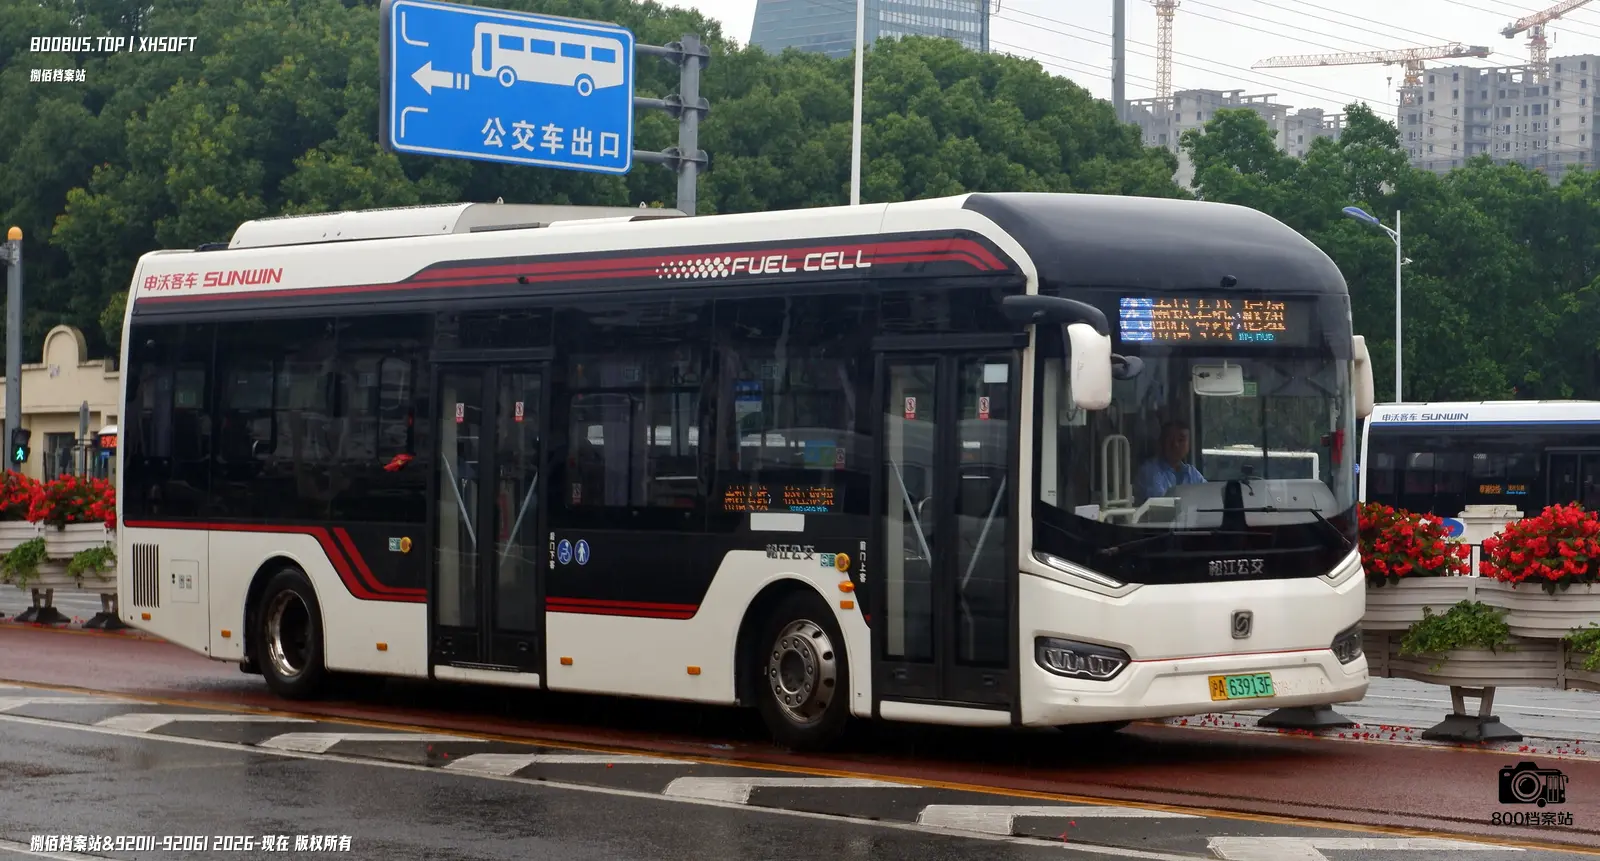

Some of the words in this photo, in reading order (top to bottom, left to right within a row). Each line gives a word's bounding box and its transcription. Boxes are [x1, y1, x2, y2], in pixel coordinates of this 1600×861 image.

[481, 117, 620, 159] 公交车出口
[731, 255, 797, 275] FUEL
[803, 250, 872, 271] CELL
[144, 272, 199, 291] 申沃客车
[203, 268, 283, 287] SUNWIN
[1382, 413, 1418, 421] 申沃客车
[1421, 413, 1469, 421] SUNWIN
[1208, 558, 1265, 576] 松江公交
